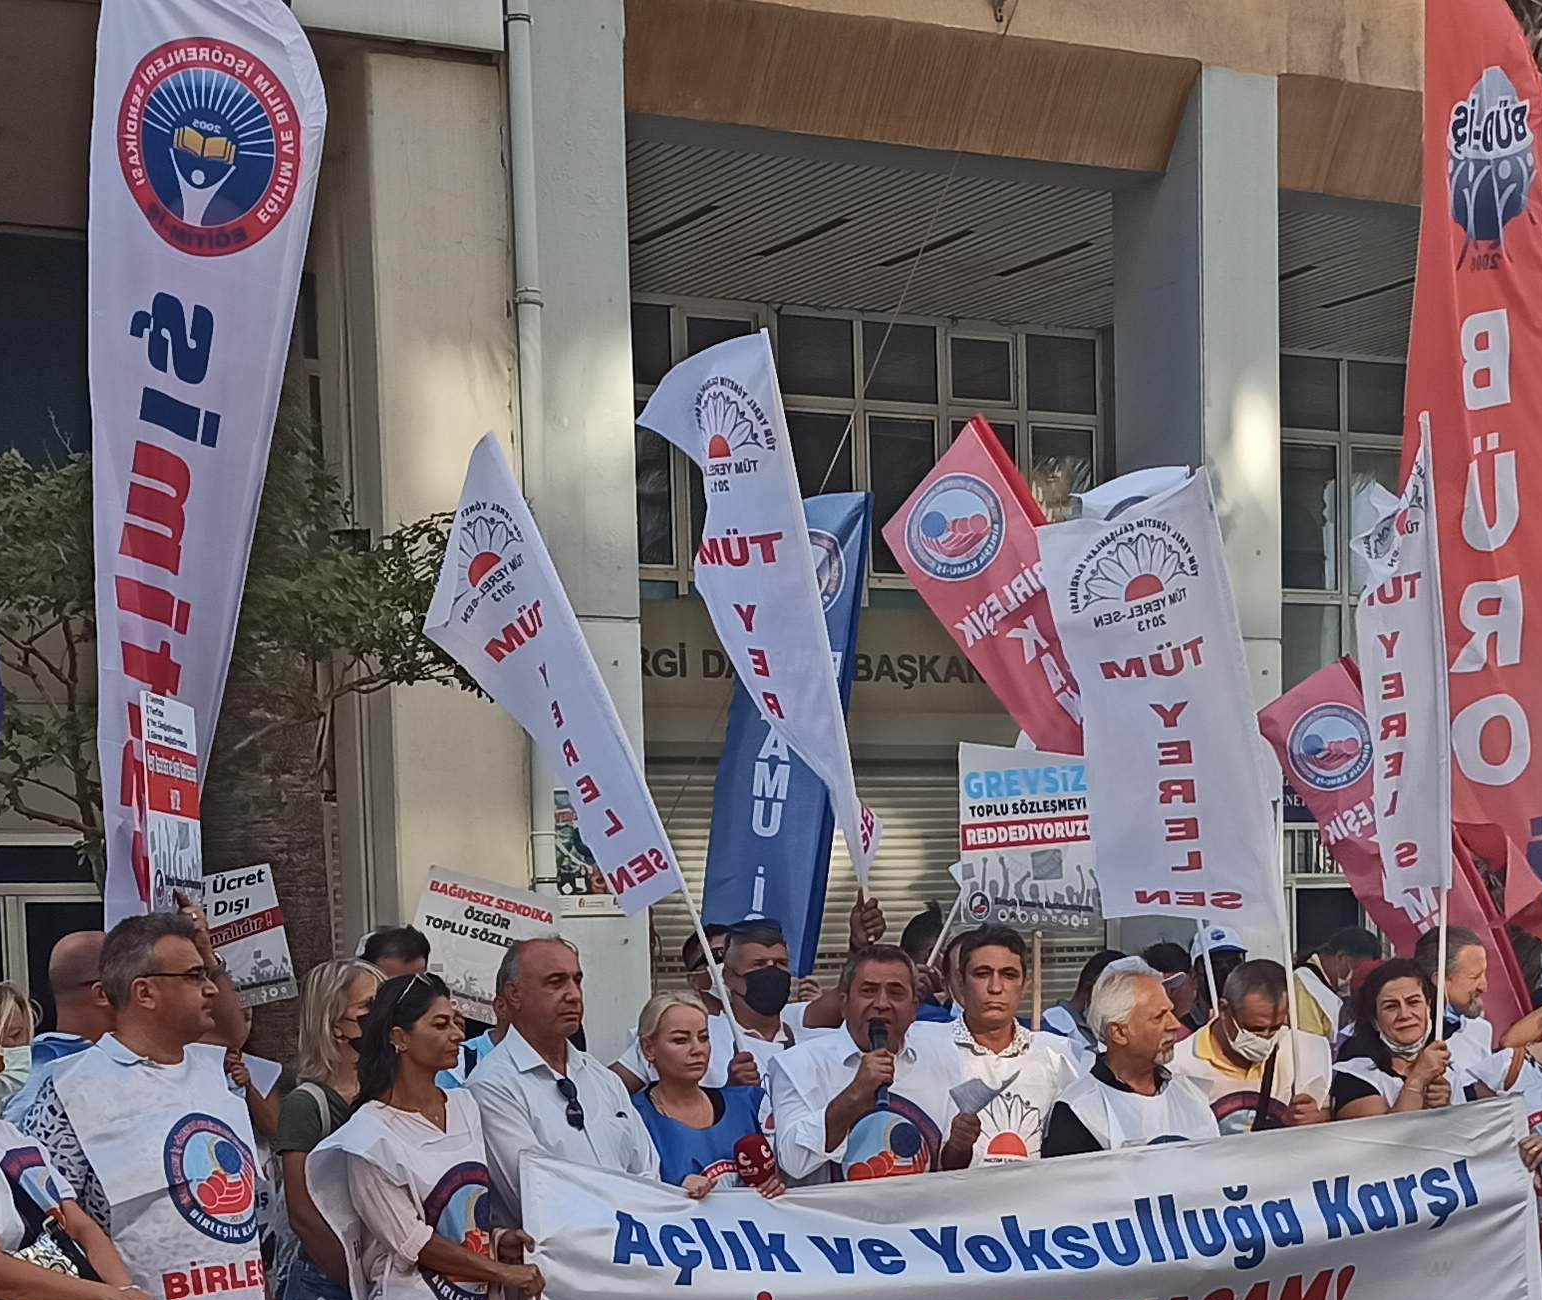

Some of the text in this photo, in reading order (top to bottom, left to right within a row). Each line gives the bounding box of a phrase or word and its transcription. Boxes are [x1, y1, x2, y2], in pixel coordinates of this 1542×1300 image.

[964, 764, 1088, 800] GREVSİZ
[969, 803, 1009, 818] TOPLU
[212, 868, 265, 894] Ücret
[214, 897, 250, 917] Dışı
[428, 879, 494, 910] BAĞIMSIZ
[425, 915, 469, 937] TOPLU
[464, 905, 511, 931] ÖZGÜR
[612, 1158, 1480, 1287] Açlık ve Yoksulluğa Karşı
